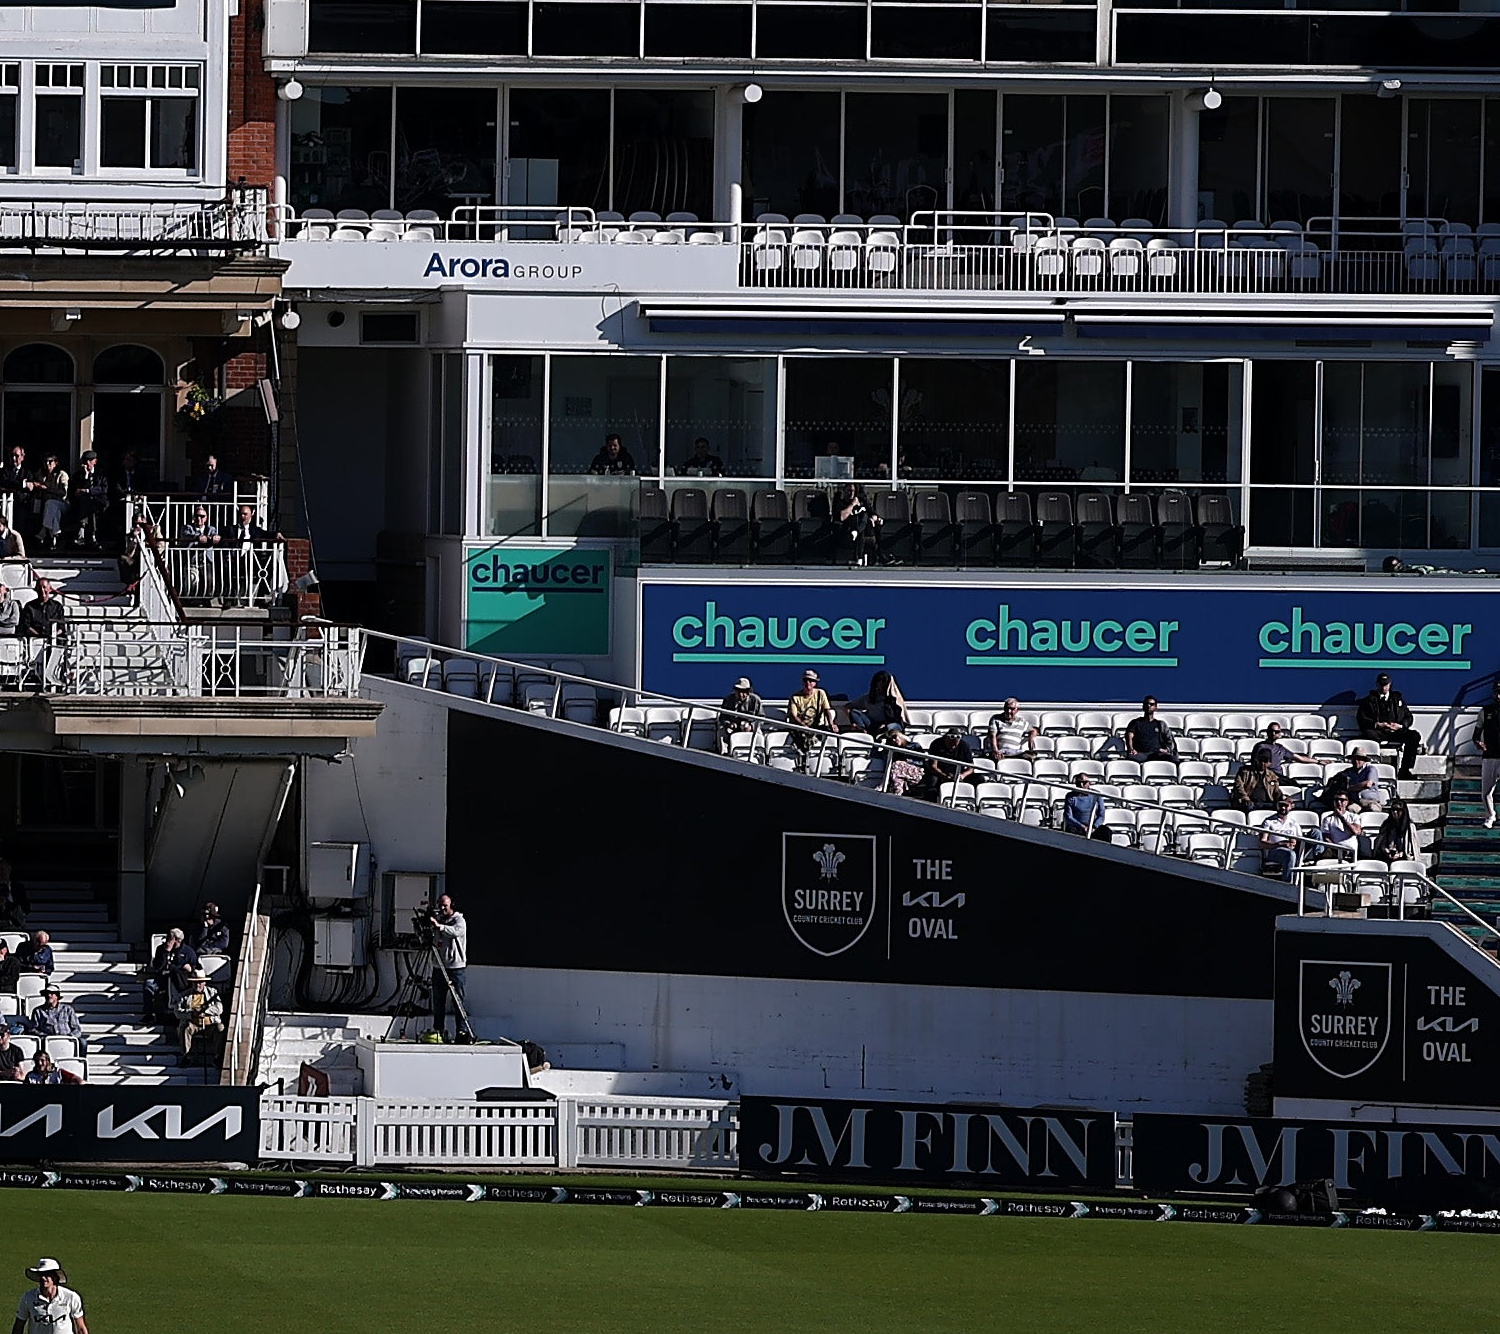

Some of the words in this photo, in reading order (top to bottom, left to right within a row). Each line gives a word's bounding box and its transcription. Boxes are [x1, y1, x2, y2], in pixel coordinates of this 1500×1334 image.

[423, 252, 510, 278] Arora
[513, 265, 582, 279] GROUP
[470, 552, 605, 586] chaucer
[672, 601, 886, 650] chaucer
[965, 603, 1179, 652] chaucer
[1258, 606, 1472, 655] chaucer
[912, 858, 953, 880] THE
[794, 889, 864, 912] SURREY
[902, 890, 966, 908] KIA
[793, 914, 818, 924] COUNTY
[819, 915, 846, 925] CRICKET
[846, 916, 863, 925] CLUB
[908, 917, 958, 940] OVAL
[1426, 985, 1466, 1006] THE
[1310, 1014, 1379, 1036] SURREY
[1416, 1015, 1479, 1033] KIA
[1310, 1038, 1334, 1047] COUNTY
[1334, 1039, 1361, 1048] CRICKET
[1361, 1040, 1378, 1049] CLUB
[1422, 1041, 1472, 1063] OVAL
[96, 1104, 243, 1141] KIA
[759, 1105, 871, 1169] JM
[896, 1110, 1097, 1180] FINN
[1188, 1123, 1305, 1187] JM
